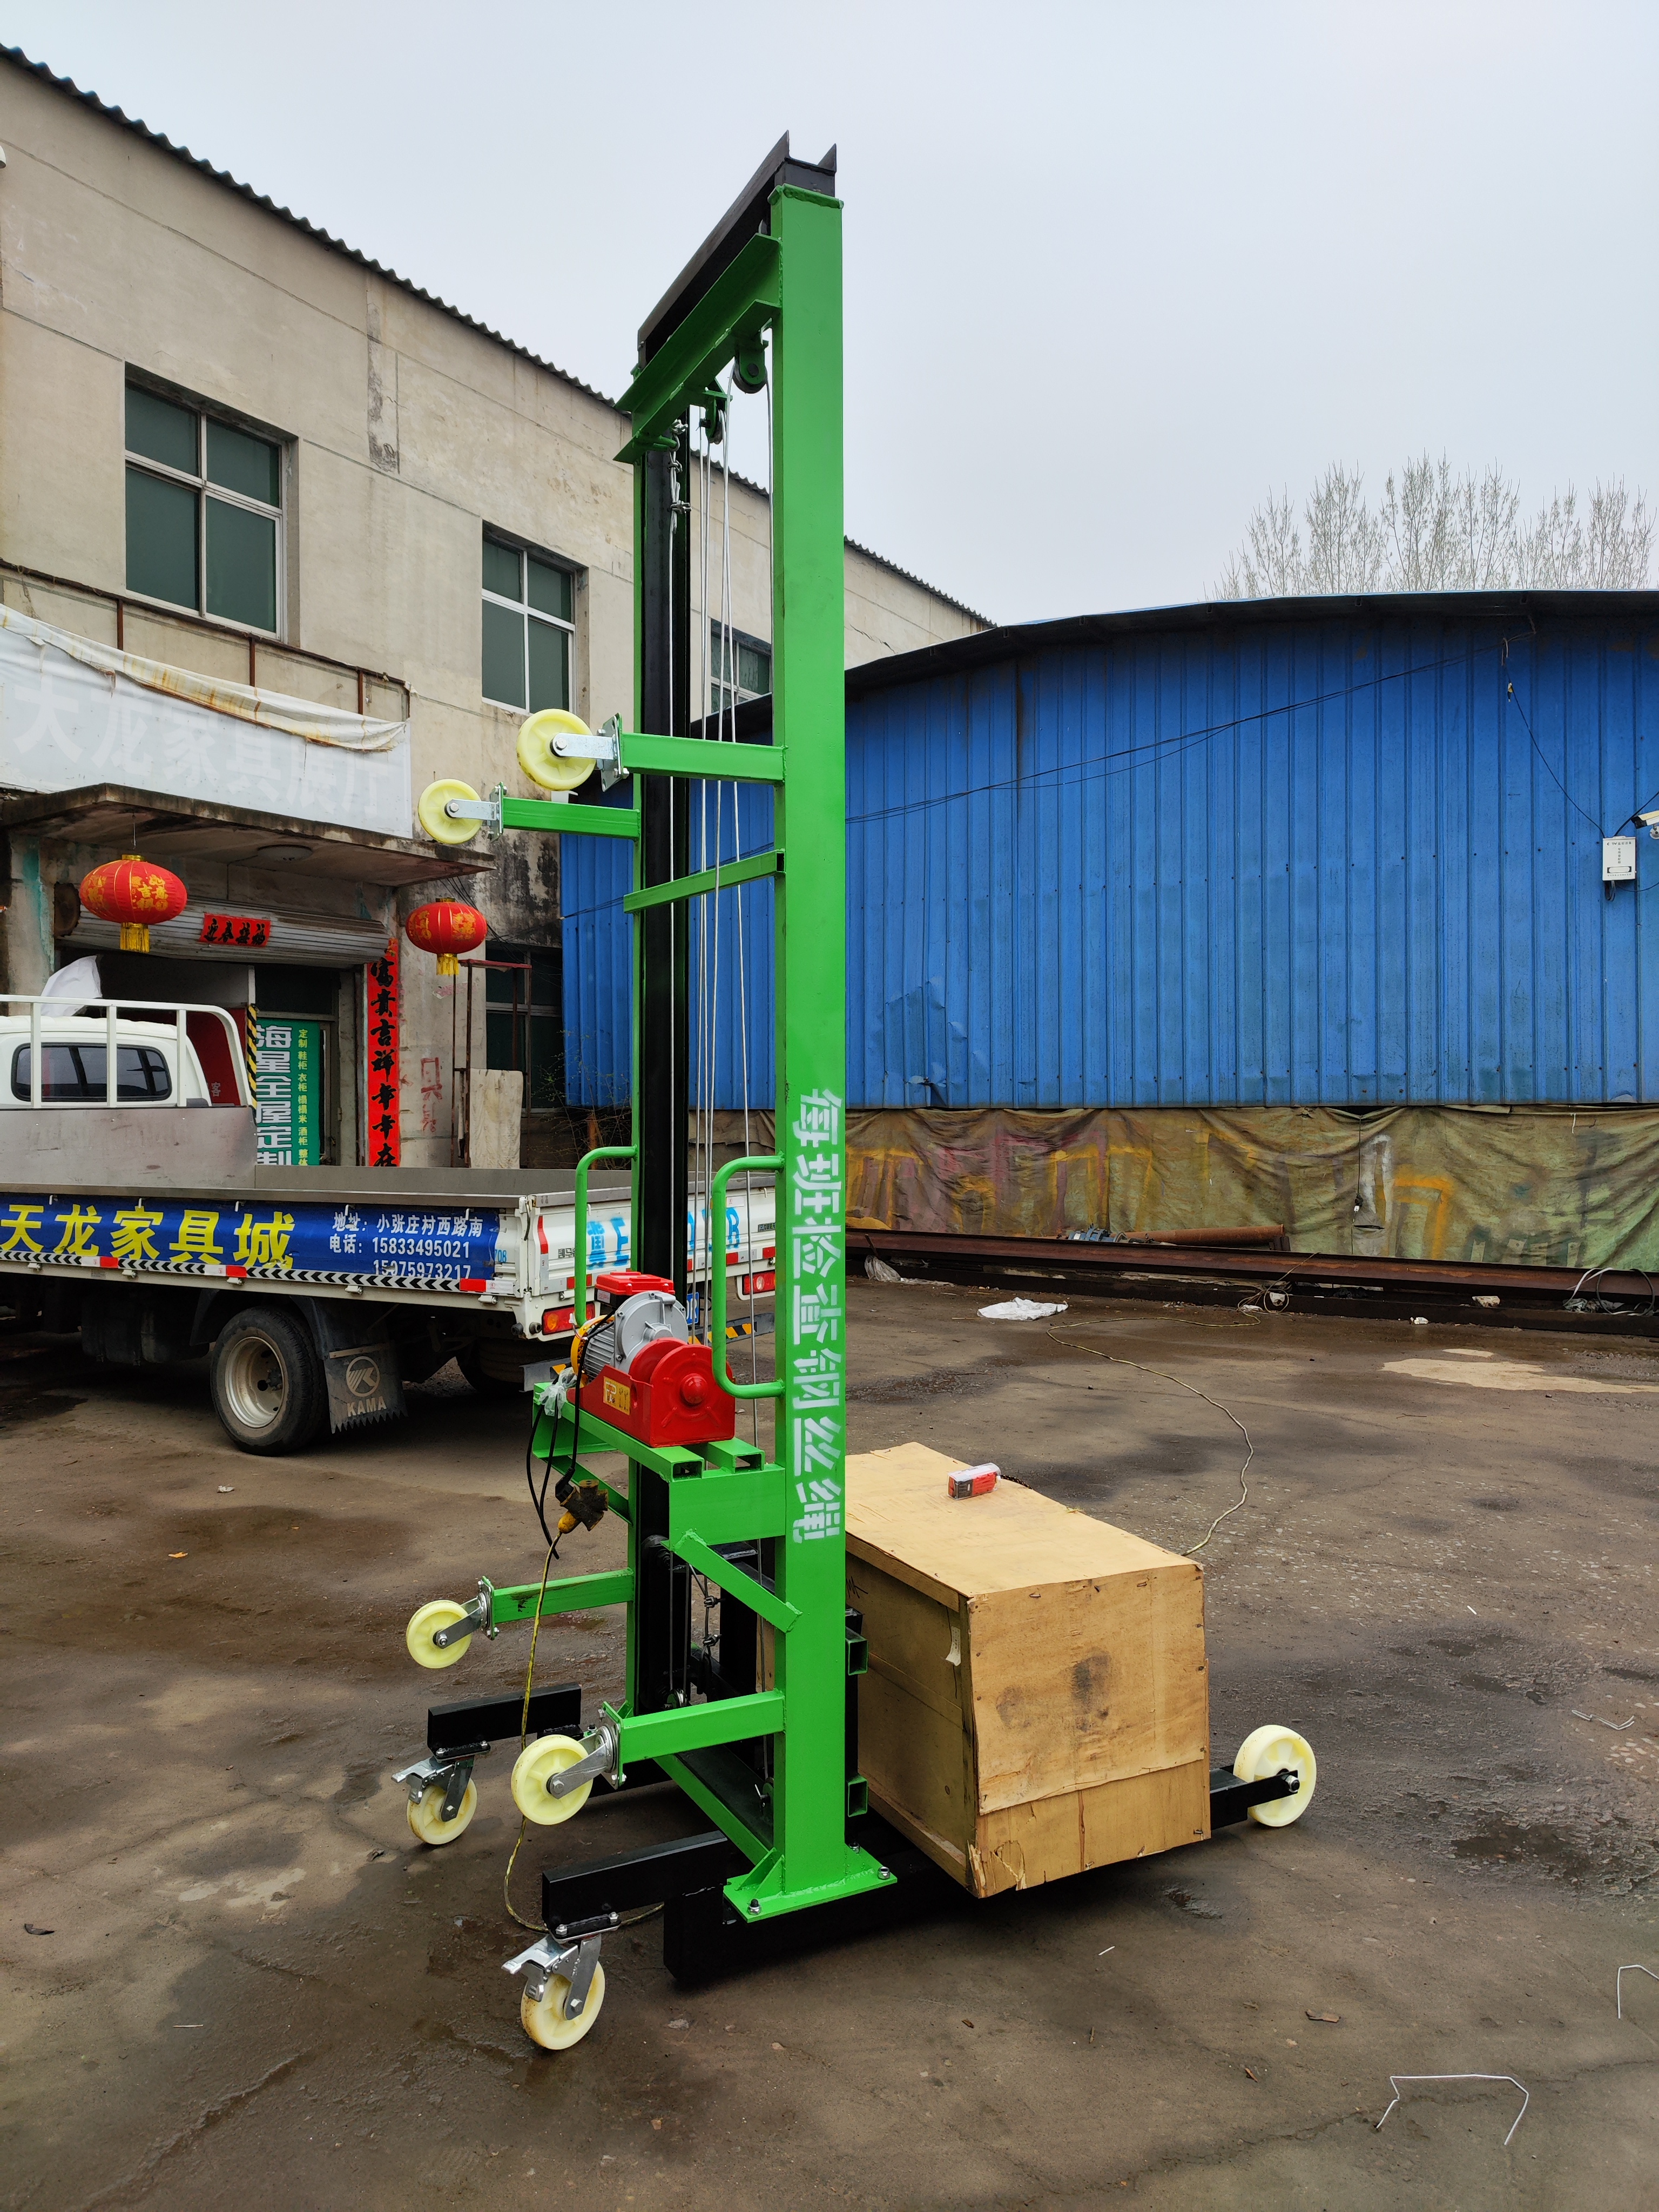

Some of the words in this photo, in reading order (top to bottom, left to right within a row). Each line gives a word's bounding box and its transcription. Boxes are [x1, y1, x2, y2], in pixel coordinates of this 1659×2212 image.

[298, 1029, 308, 1048] 定制
[298, 1073, 308, 1092] 衣柜
[376, 1213, 483, 1237] 小张庄村西路南
[0, 1204, 295, 1270] 天龙家具城
[372, 1237, 470, 1258] 15833495021
[793, 1088, 842, 1544] 每班检查钢丝绳
[347, 1395, 387, 1417] KAMA
